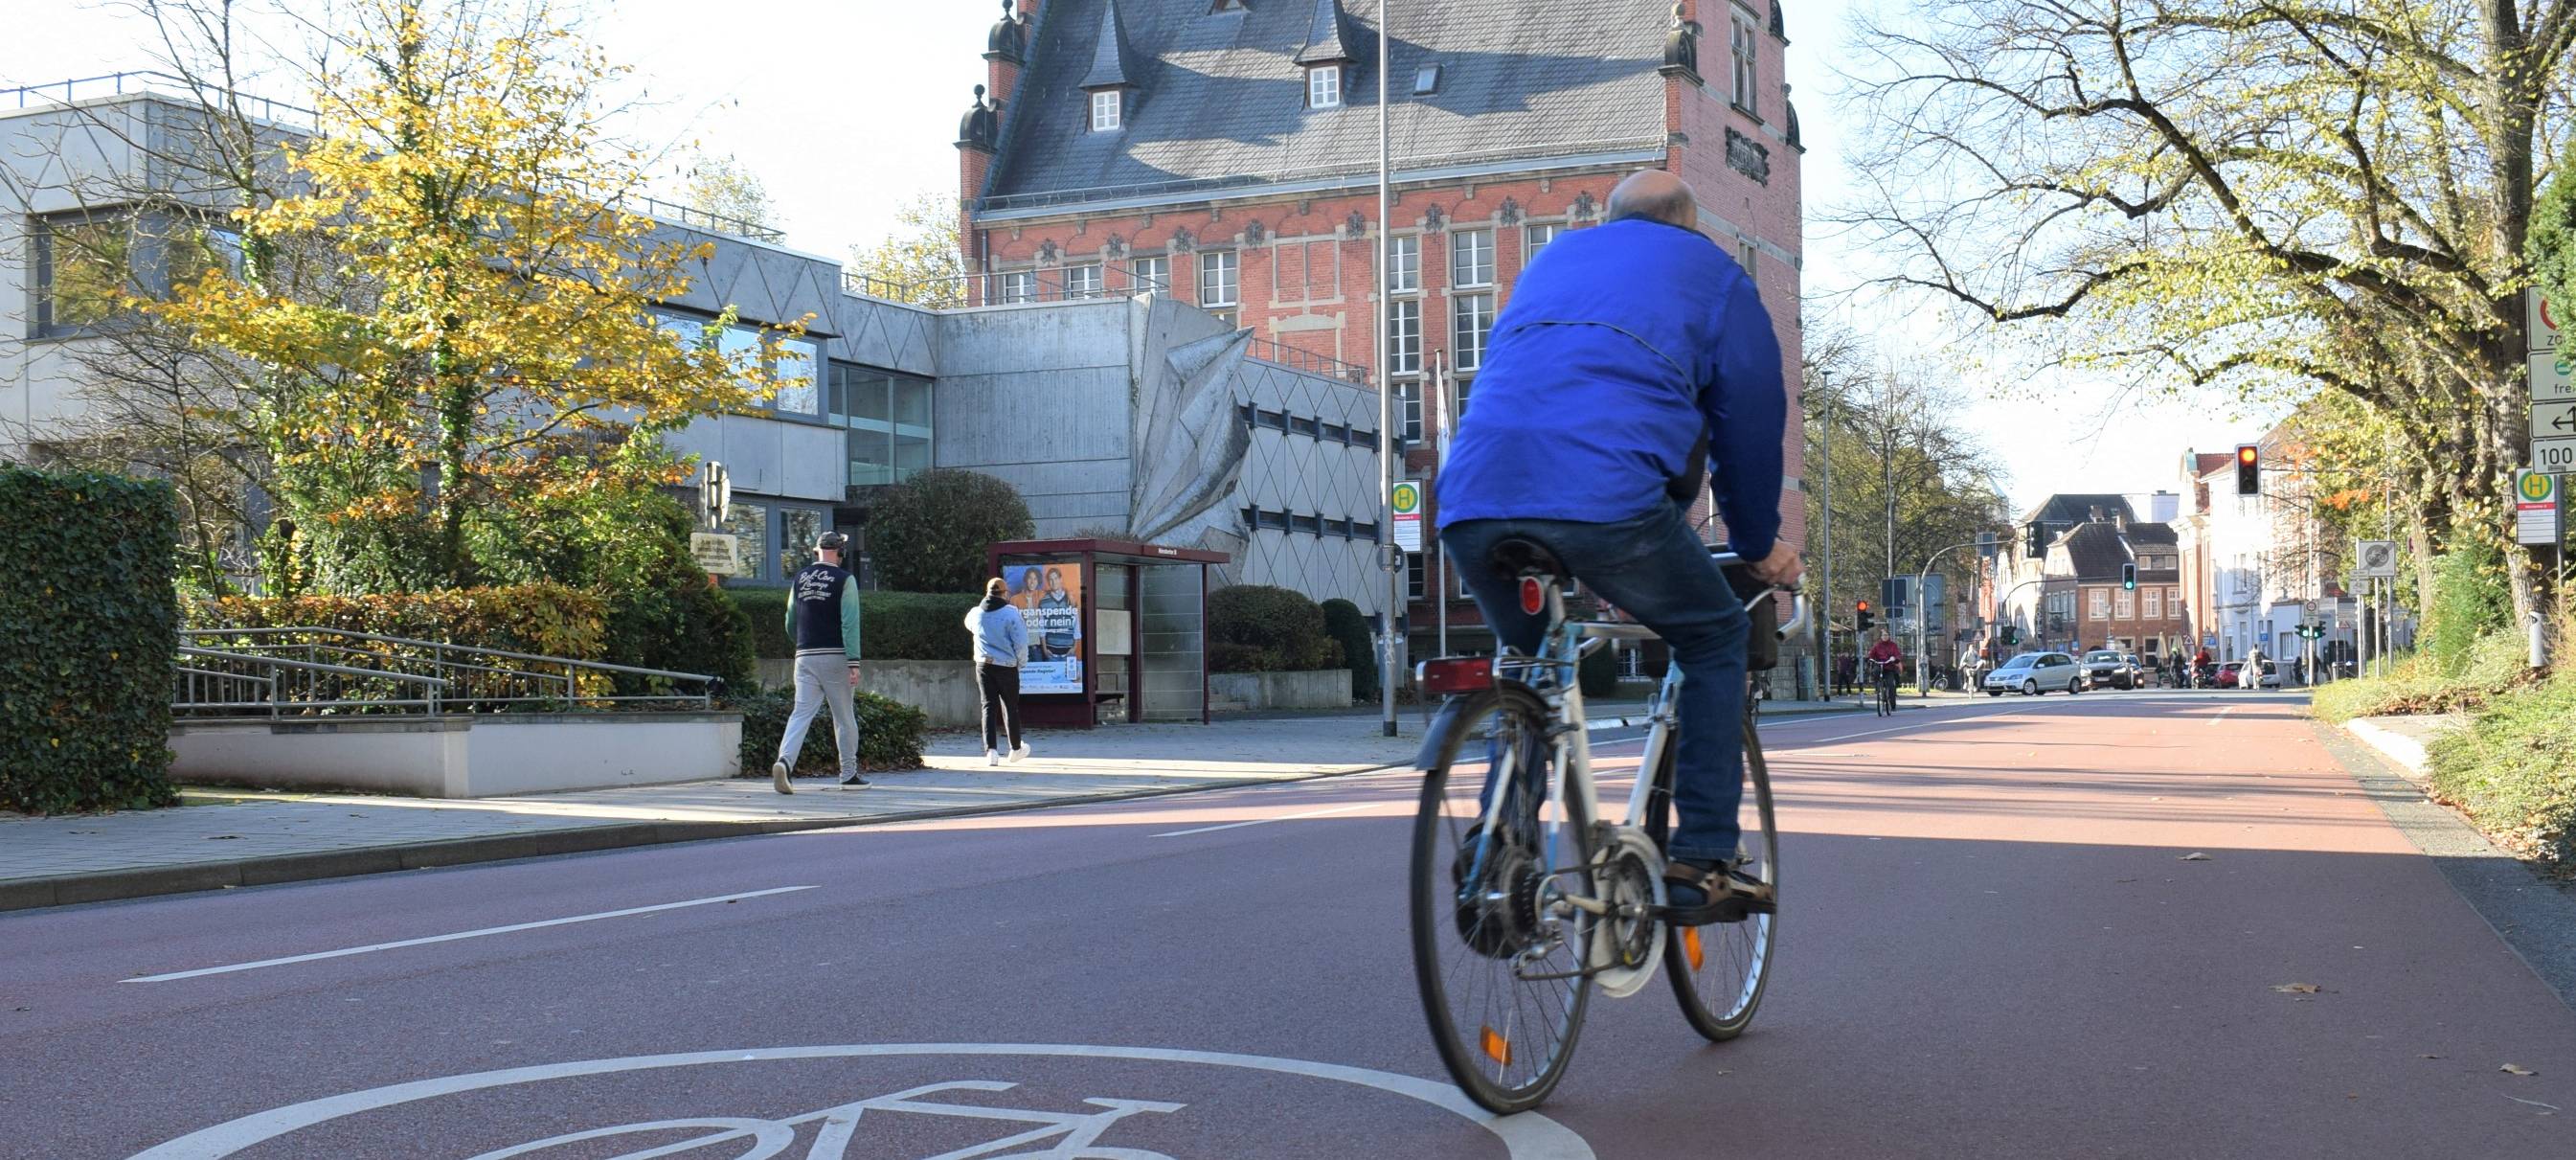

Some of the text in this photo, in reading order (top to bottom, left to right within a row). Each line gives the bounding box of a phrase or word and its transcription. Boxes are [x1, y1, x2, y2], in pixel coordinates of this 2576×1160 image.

[2540, 447, 2572, 465] 100
[2529, 475, 2542, 494] H
[1399, 489, 1410, 507] H
[1018, 605, 1078, 619] rganspende
[1027, 616, 1075, 627] oder nein?
